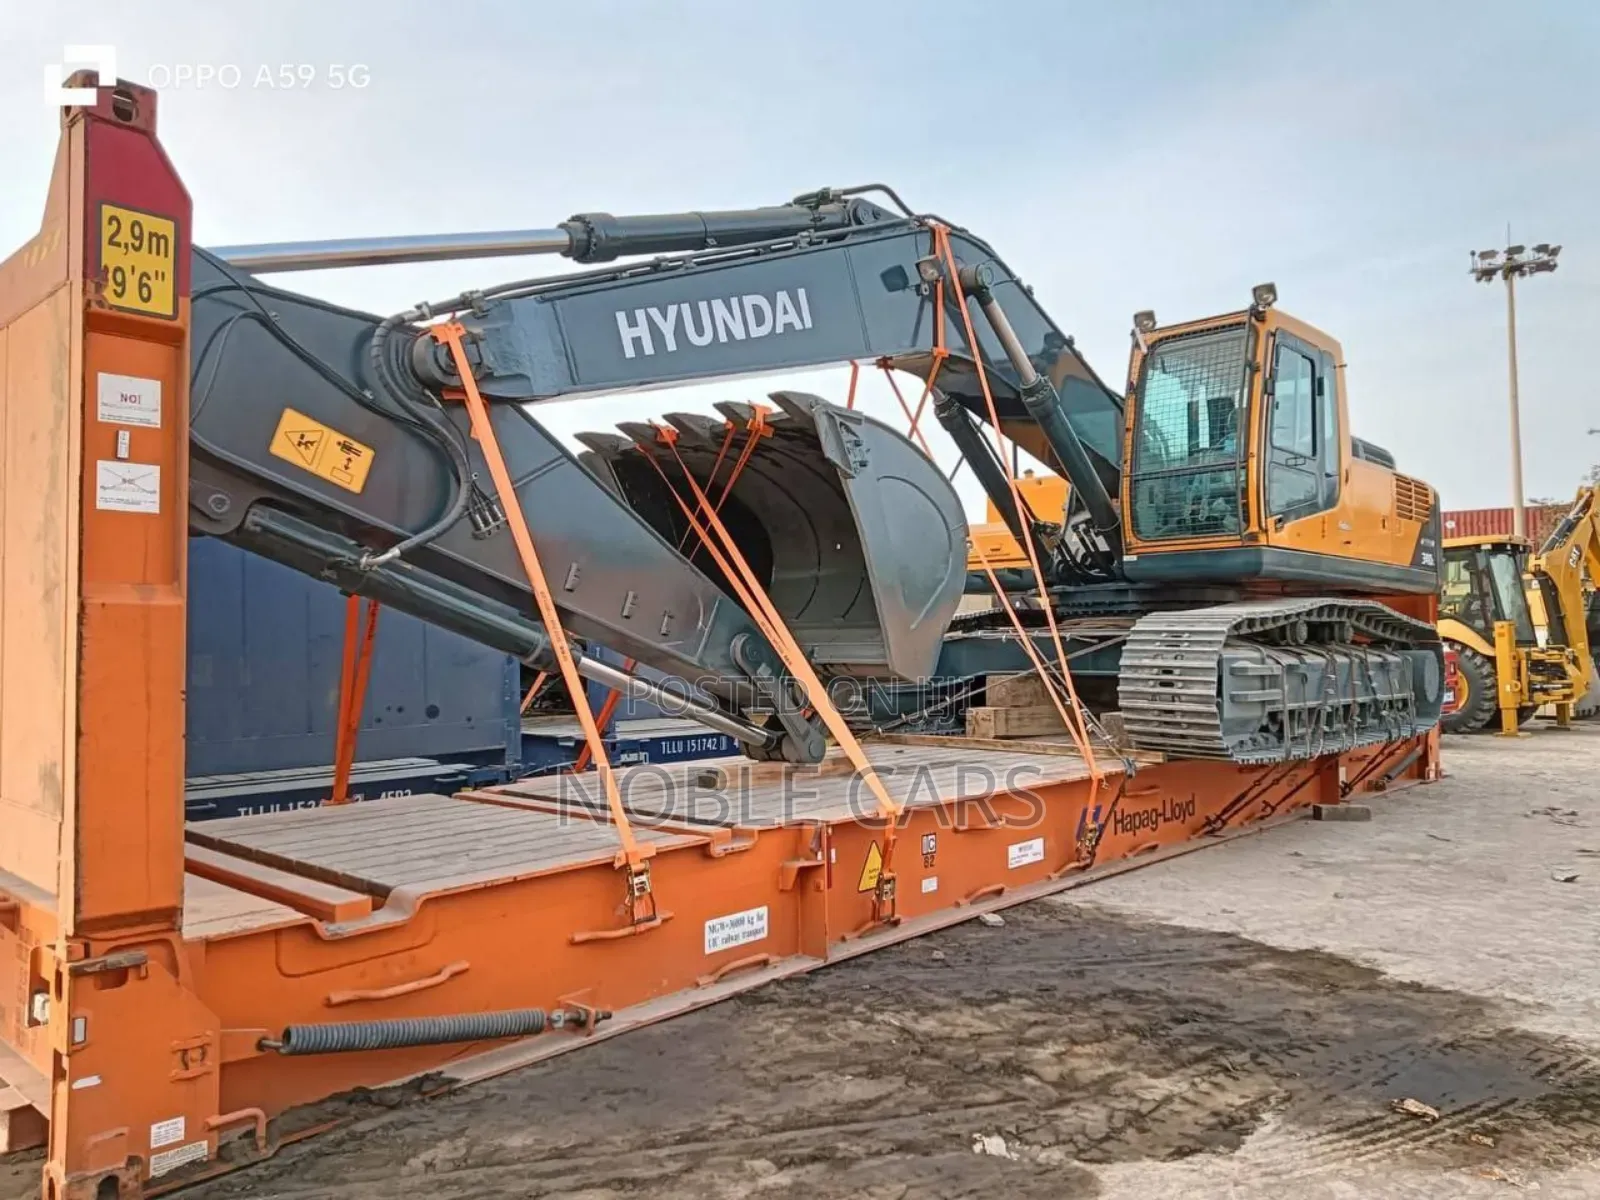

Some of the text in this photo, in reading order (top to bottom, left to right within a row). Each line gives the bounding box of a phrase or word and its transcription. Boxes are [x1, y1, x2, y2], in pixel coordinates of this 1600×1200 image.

[615, 287, 813, 358] HYUNDAI
[661, 740, 683, 755] TLLU
[686, 737, 717, 752] 151742
[1113, 792, 1196, 836] Hapag-Lloyd
